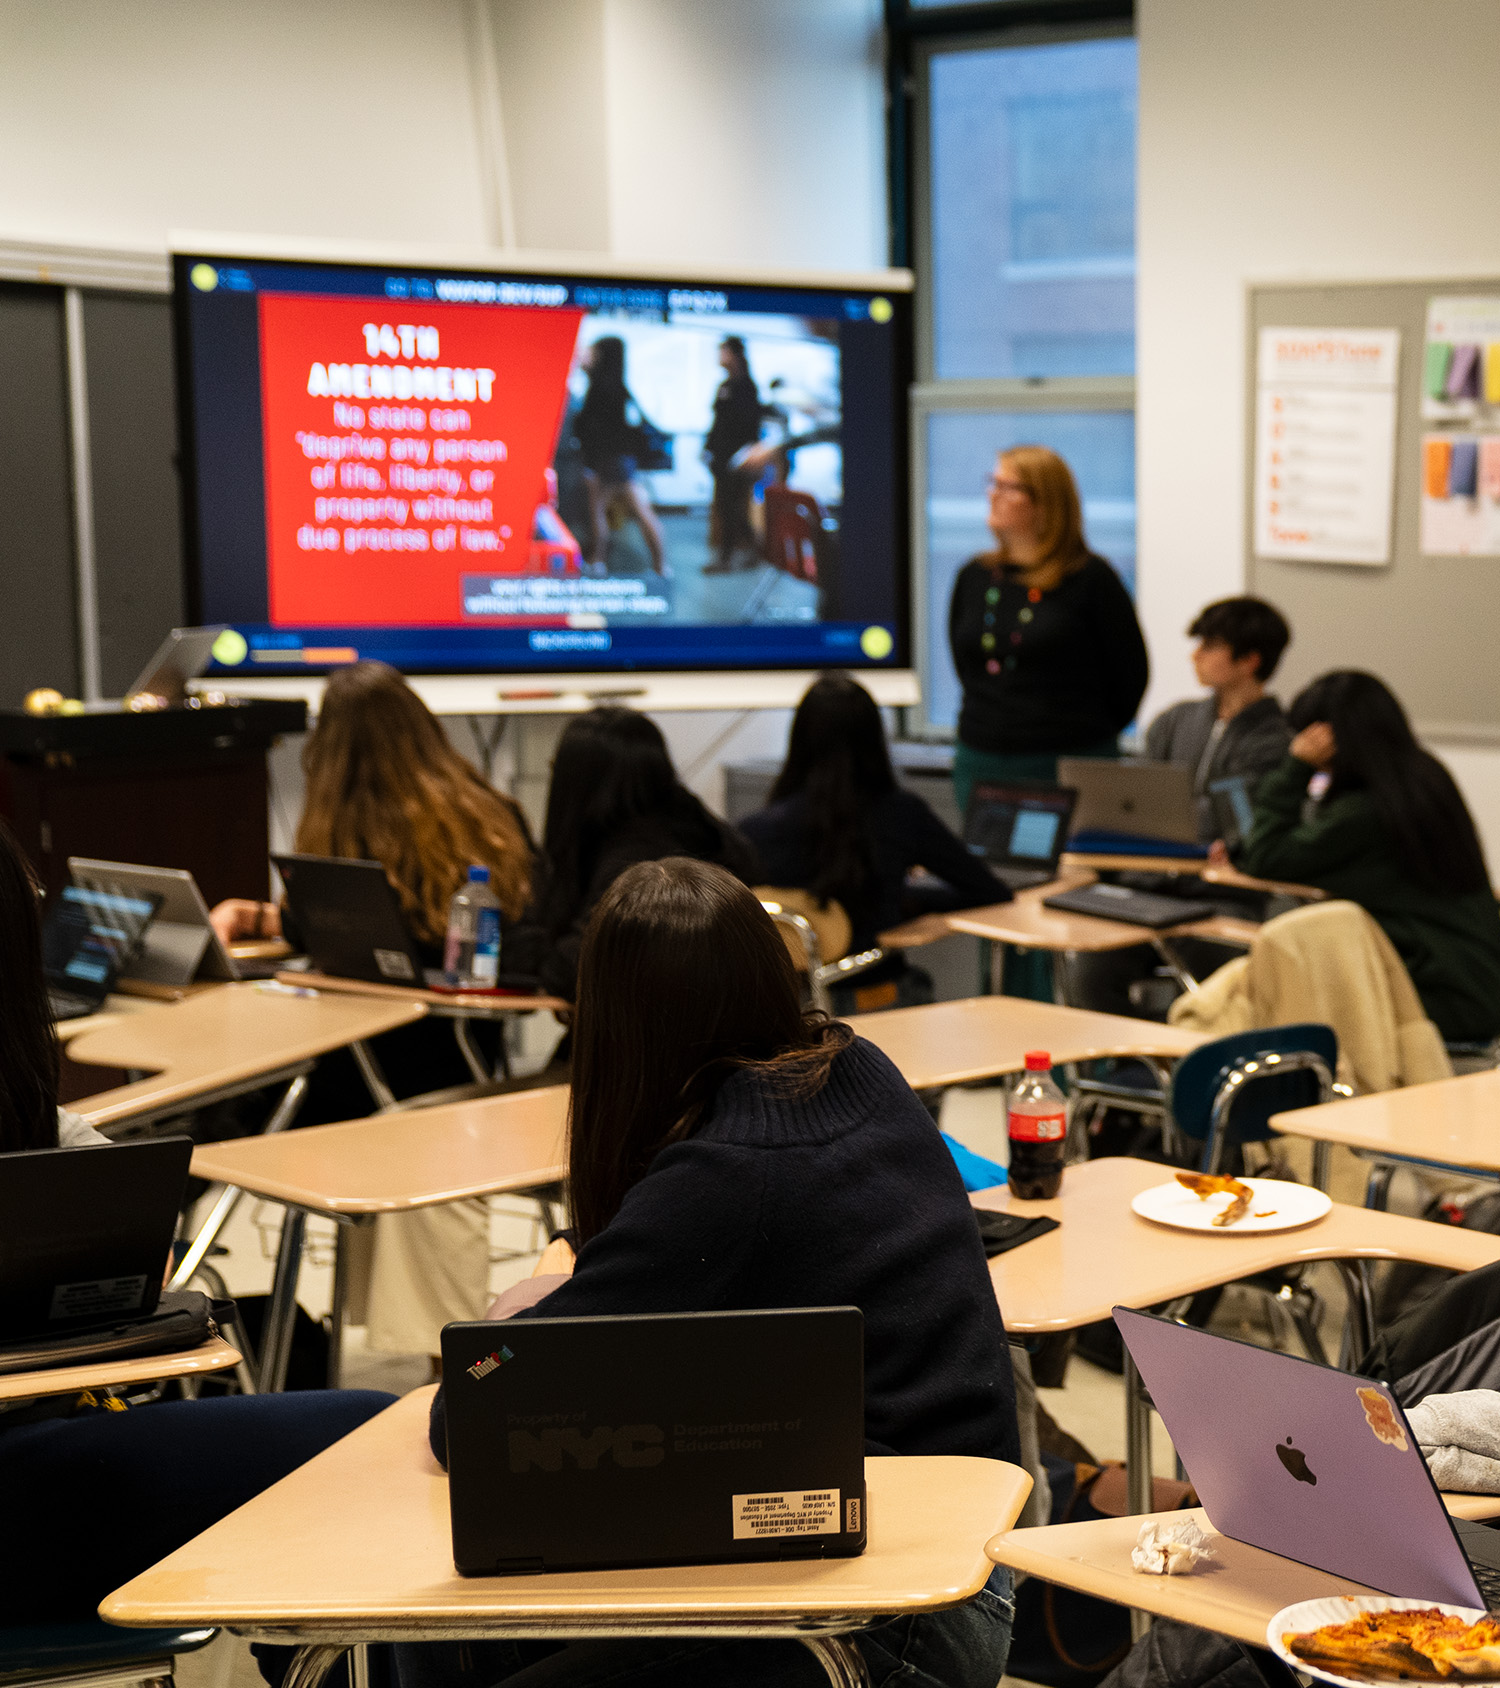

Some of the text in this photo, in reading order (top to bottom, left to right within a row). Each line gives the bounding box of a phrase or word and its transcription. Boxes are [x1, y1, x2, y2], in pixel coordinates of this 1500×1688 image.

[362, 323, 440, 361] 14TH
[307, 362, 496, 403] AMENDMENT
[333, 401, 472, 432] No state can
[389, 437, 431, 467] any
[433, 438, 508, 463] person
[311, 461, 336, 490] of
[469, 469, 495, 493] or
[315, 494, 493, 526] property without
[297, 523, 341, 551] due
[344, 528, 430, 555] process
[431, 523, 457, 552] of
[673, 1420, 779, 1440] Department
[674, 1437, 763, 1453] Education
[508, 1424, 665, 1473] NYC
[849, 1501, 858, 1530] Lenovo
